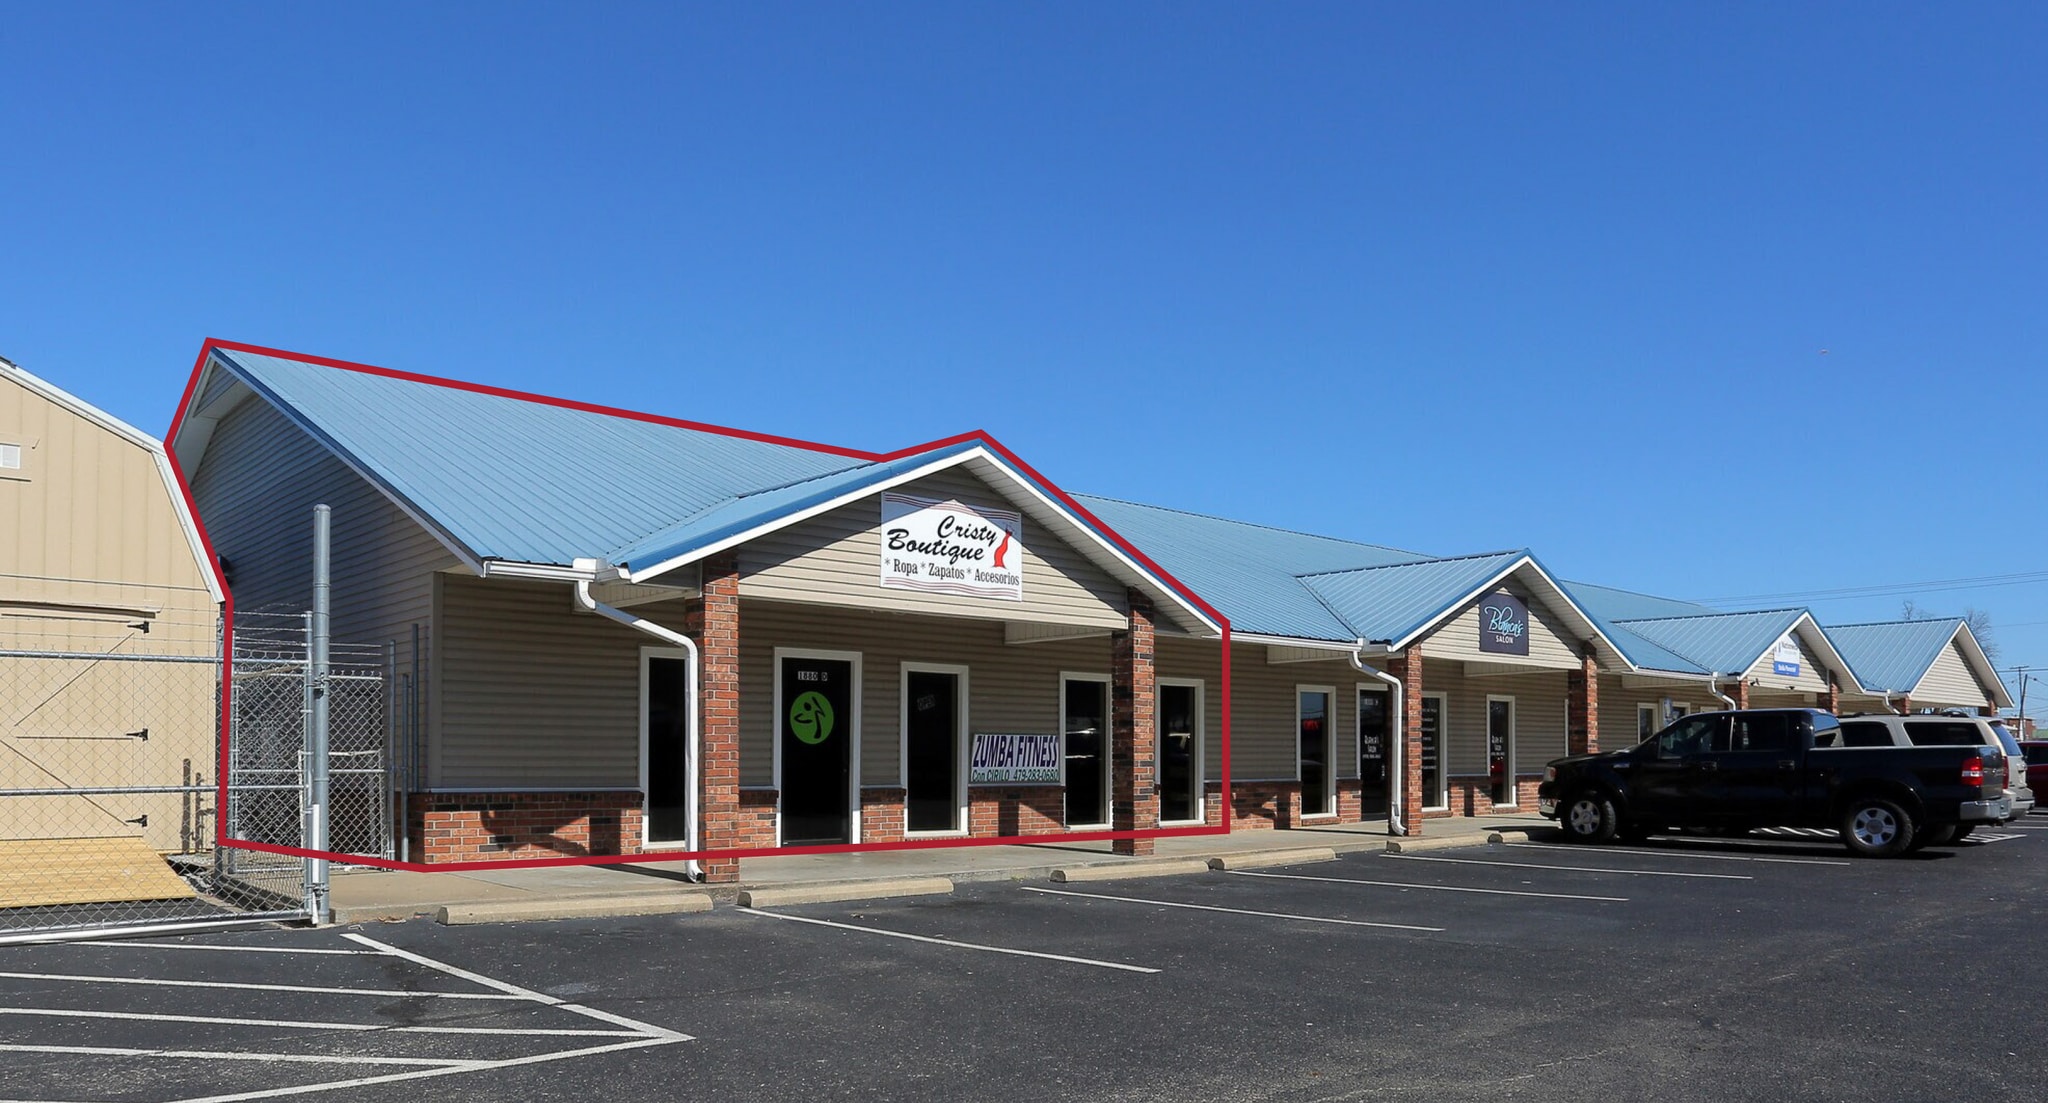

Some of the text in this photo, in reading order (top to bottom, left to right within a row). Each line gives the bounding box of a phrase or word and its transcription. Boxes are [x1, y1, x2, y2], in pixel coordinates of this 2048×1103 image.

[937, 515, 997, 547] Cristy
[886, 528, 985, 565] Boutique
[893, 558, 1020, 586] Ropa Zapatos Accesorios
[1495, 635, 1514, 644] SALON
[972, 735, 1059, 768] ZUMBA FITNESS
[972, 769, 986, 781] Con
